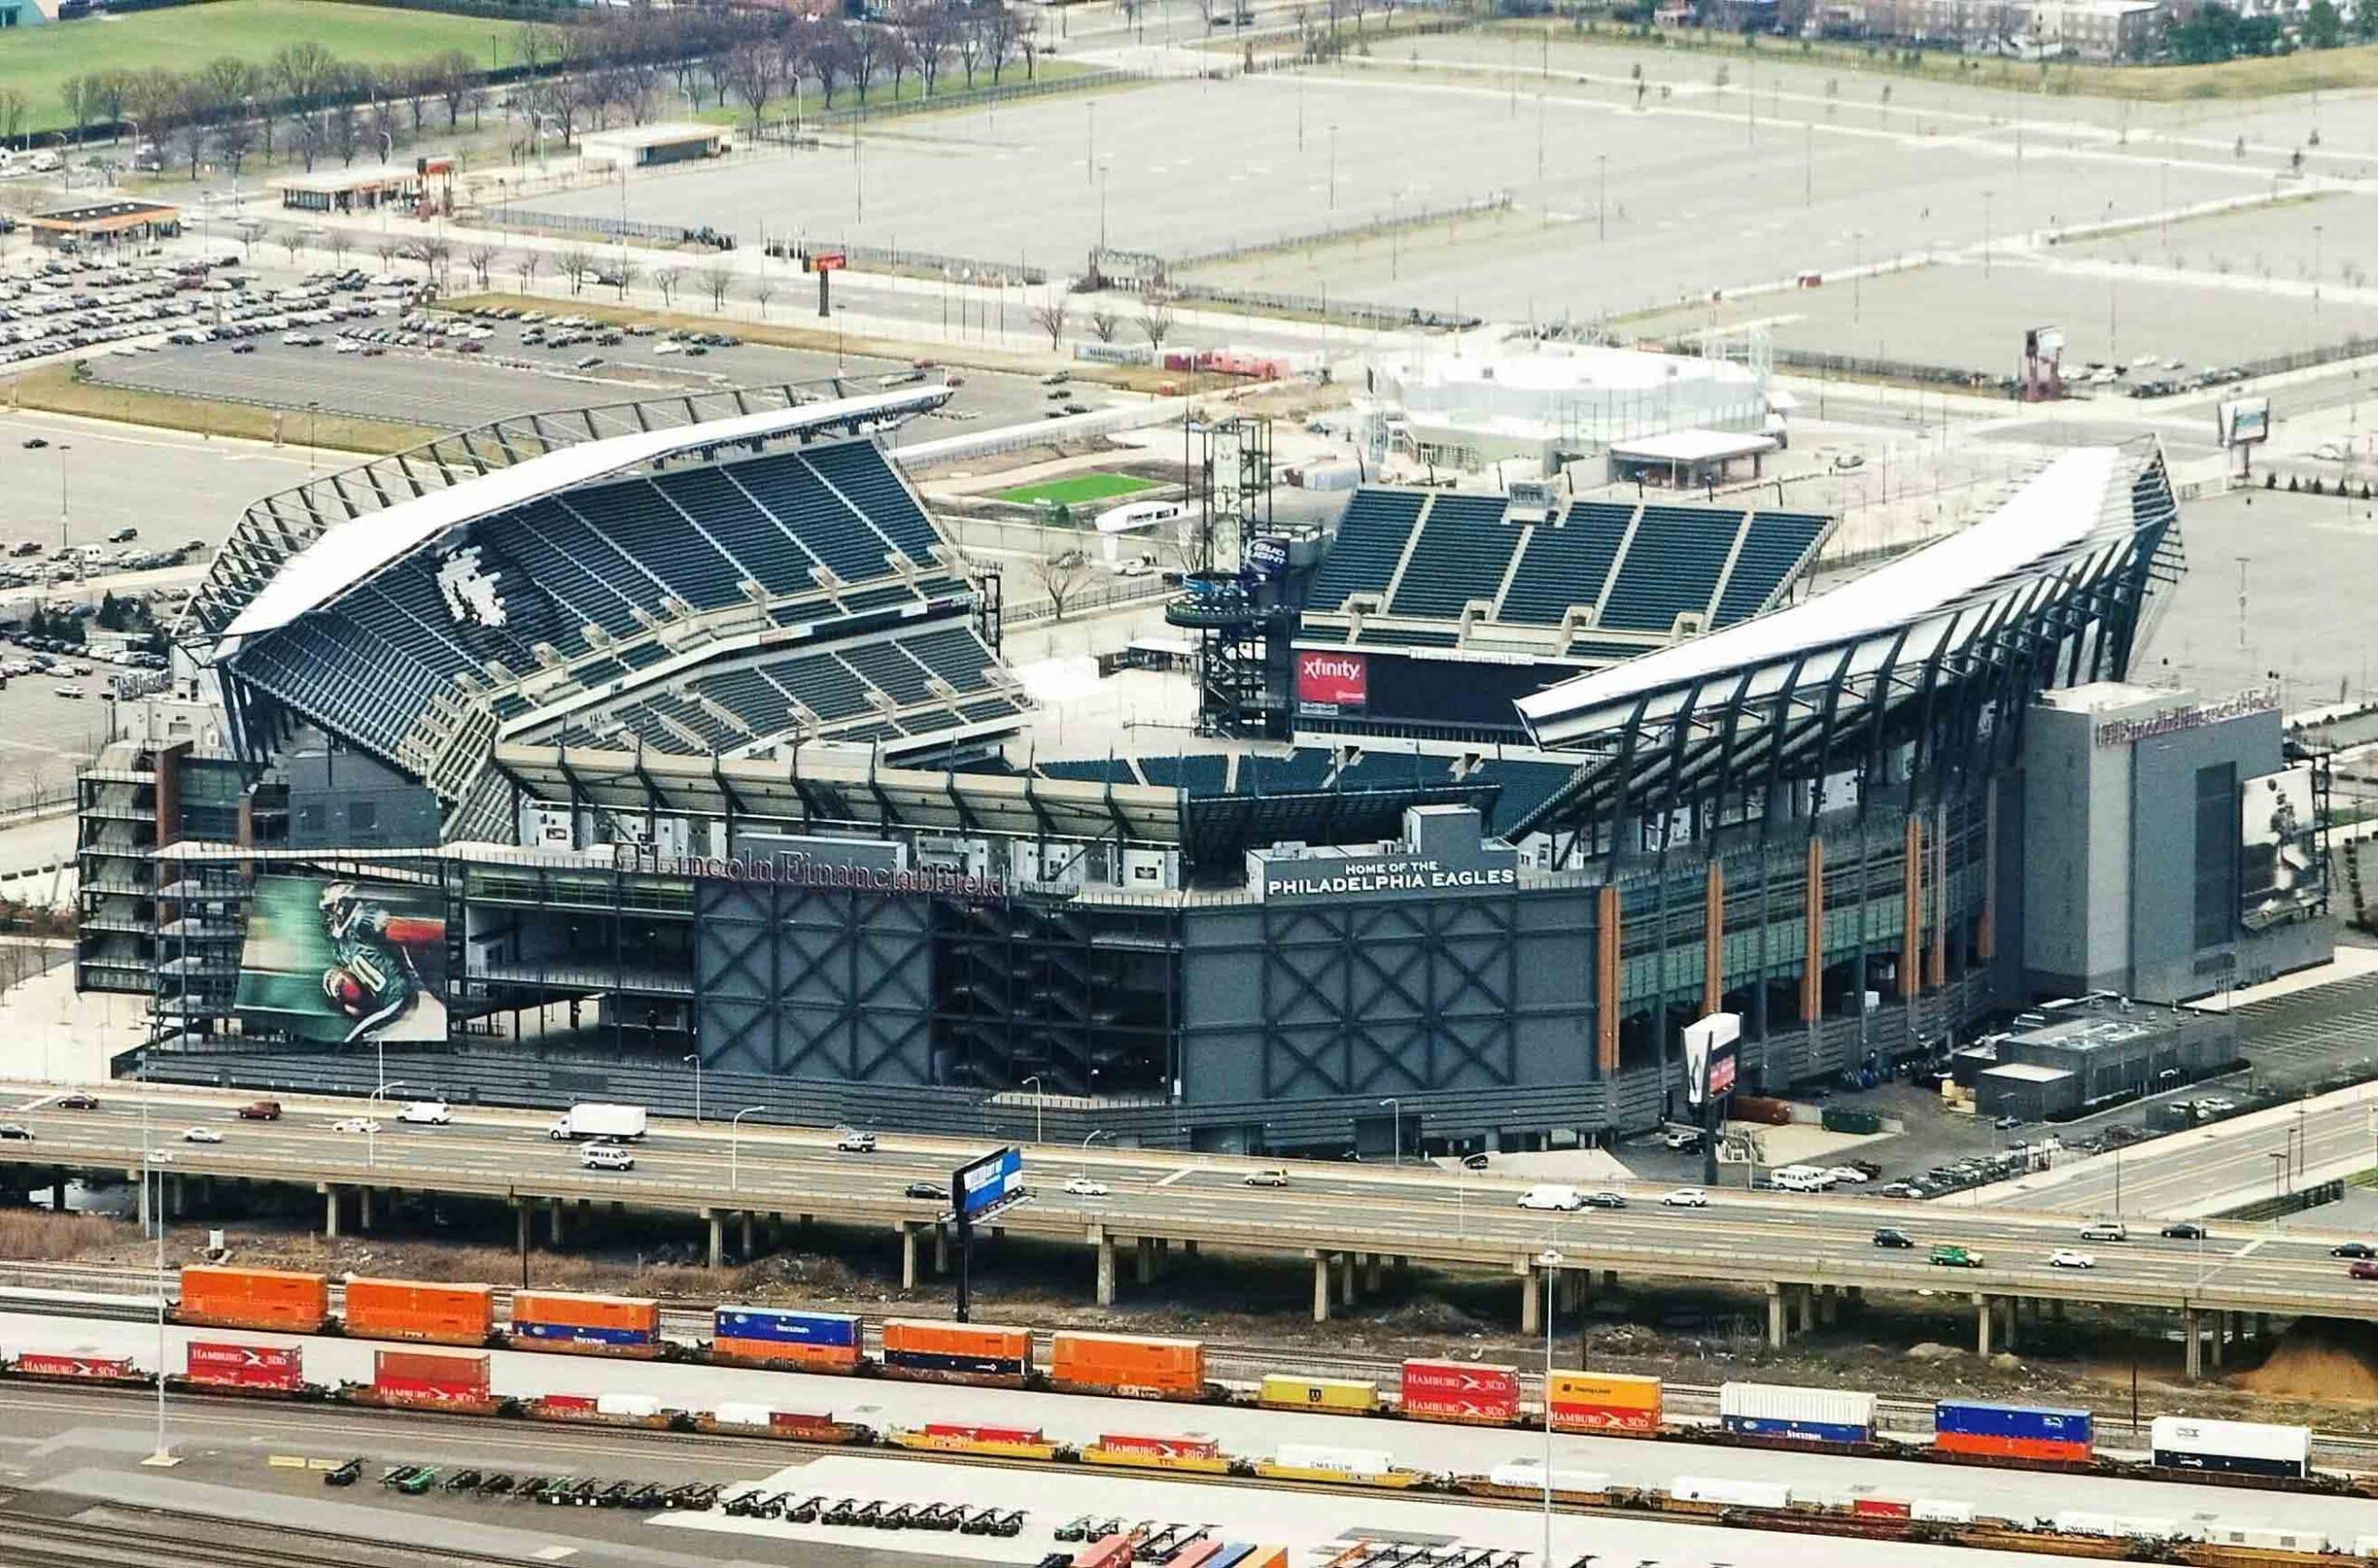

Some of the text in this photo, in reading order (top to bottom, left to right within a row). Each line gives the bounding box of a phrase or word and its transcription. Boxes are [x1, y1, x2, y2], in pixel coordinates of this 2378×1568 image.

[1304, 658, 1360, 680] xfinity
[649, 842, 776, 882] Lincoln
[777, 849, 923, 891] Financial
[1346, 860, 1439, 875] HOME OF THE
[1268, 869, 1515, 895] PHILADELPHIA EAGLES
[1407, 1372, 1460, 1388] HAMBURG
[1407, 1398, 1459, 1413] HAMBURG
